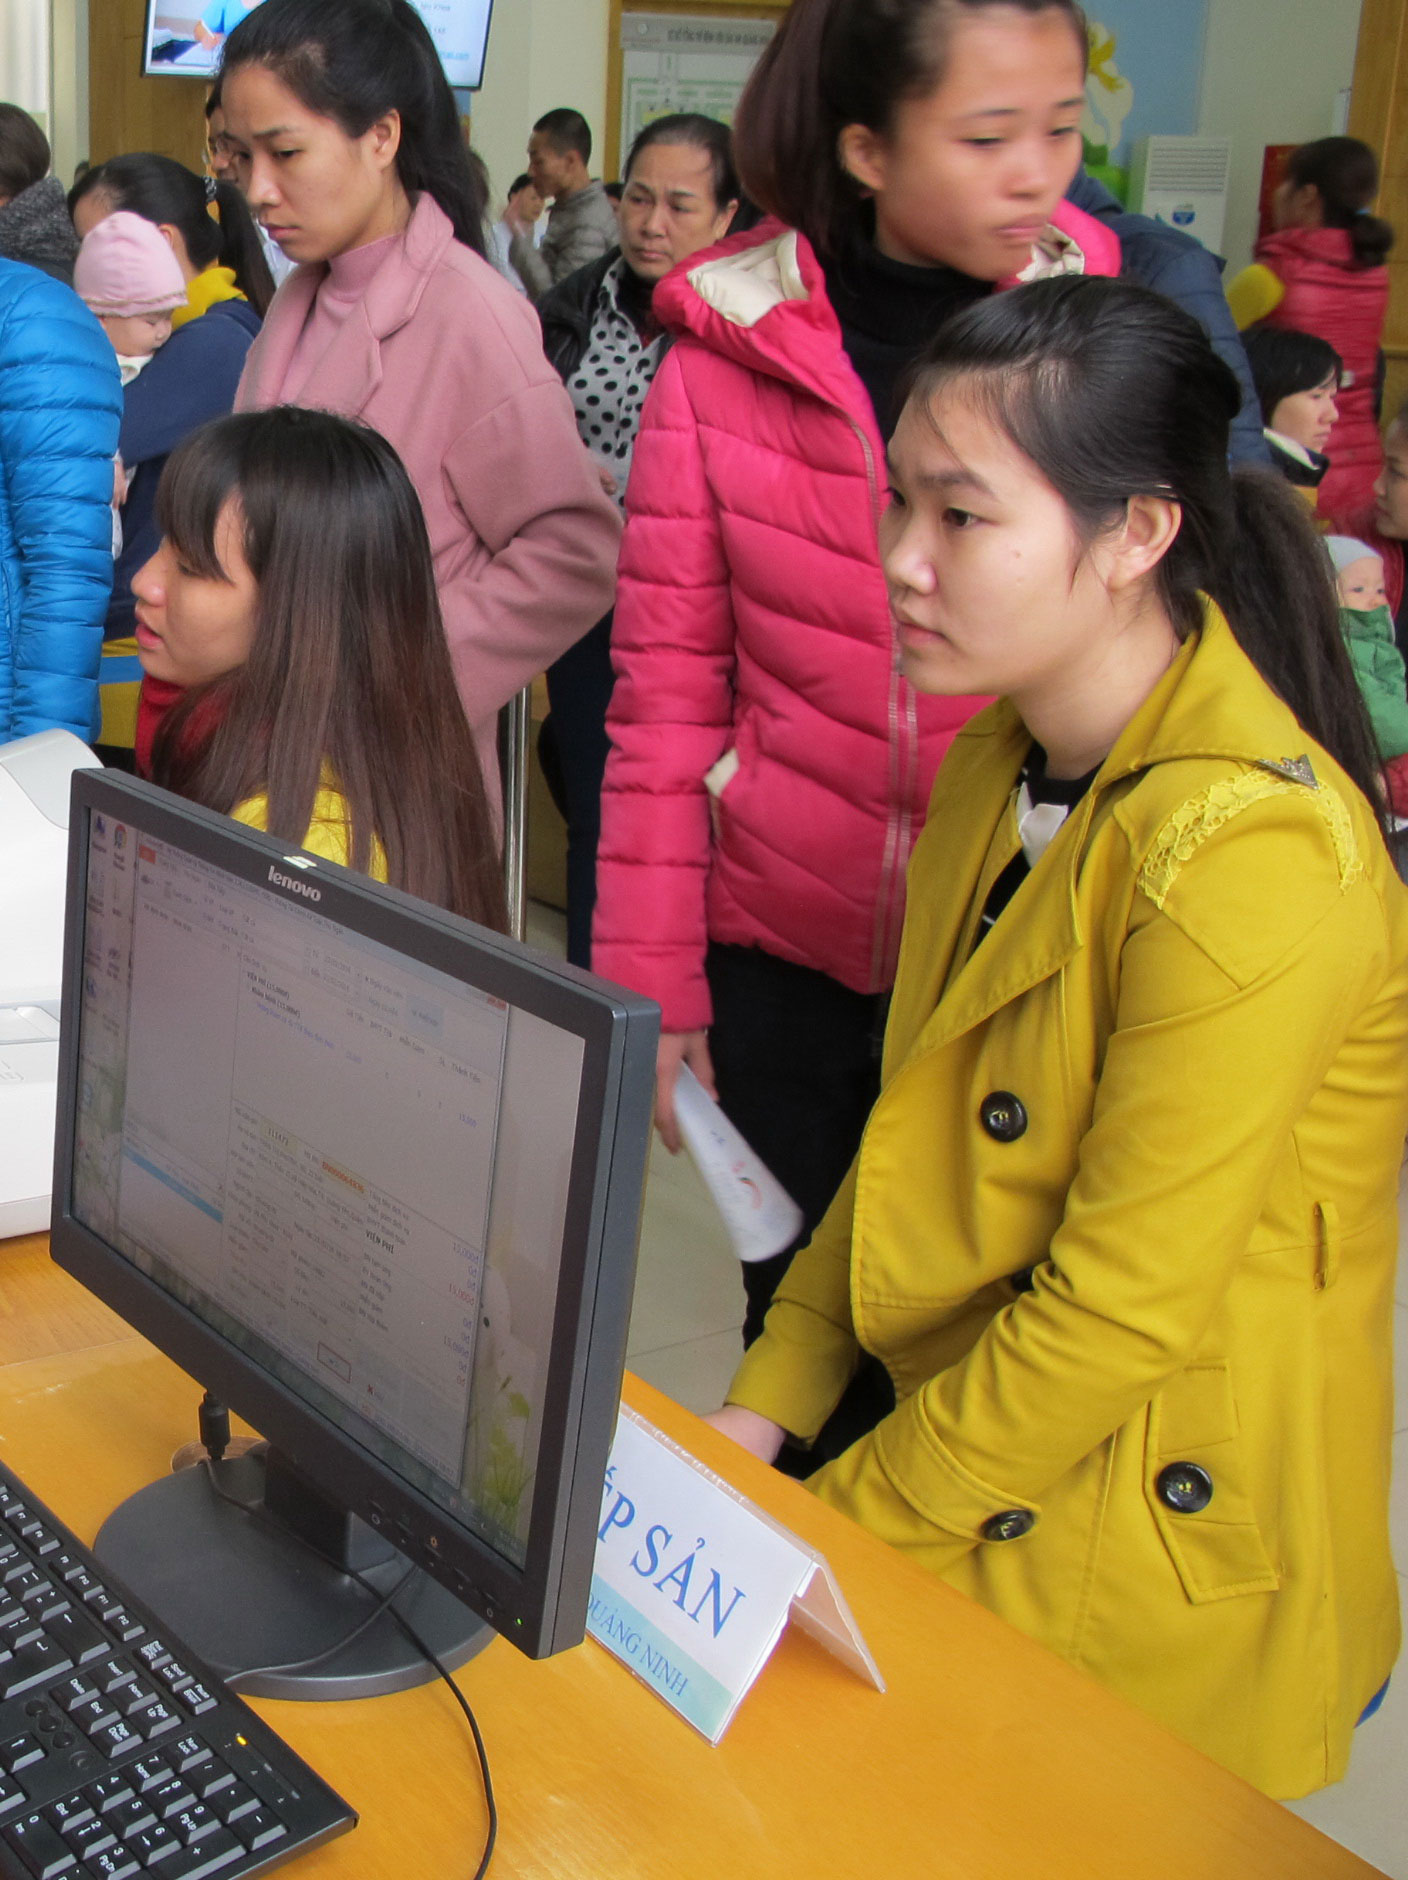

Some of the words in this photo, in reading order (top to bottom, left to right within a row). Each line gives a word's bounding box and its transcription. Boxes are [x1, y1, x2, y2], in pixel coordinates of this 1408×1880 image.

[267, 865, 322, 902] lenovo
[629, 1524, 747, 1640] SẢN
[641, 1645, 689, 1697] NINH
